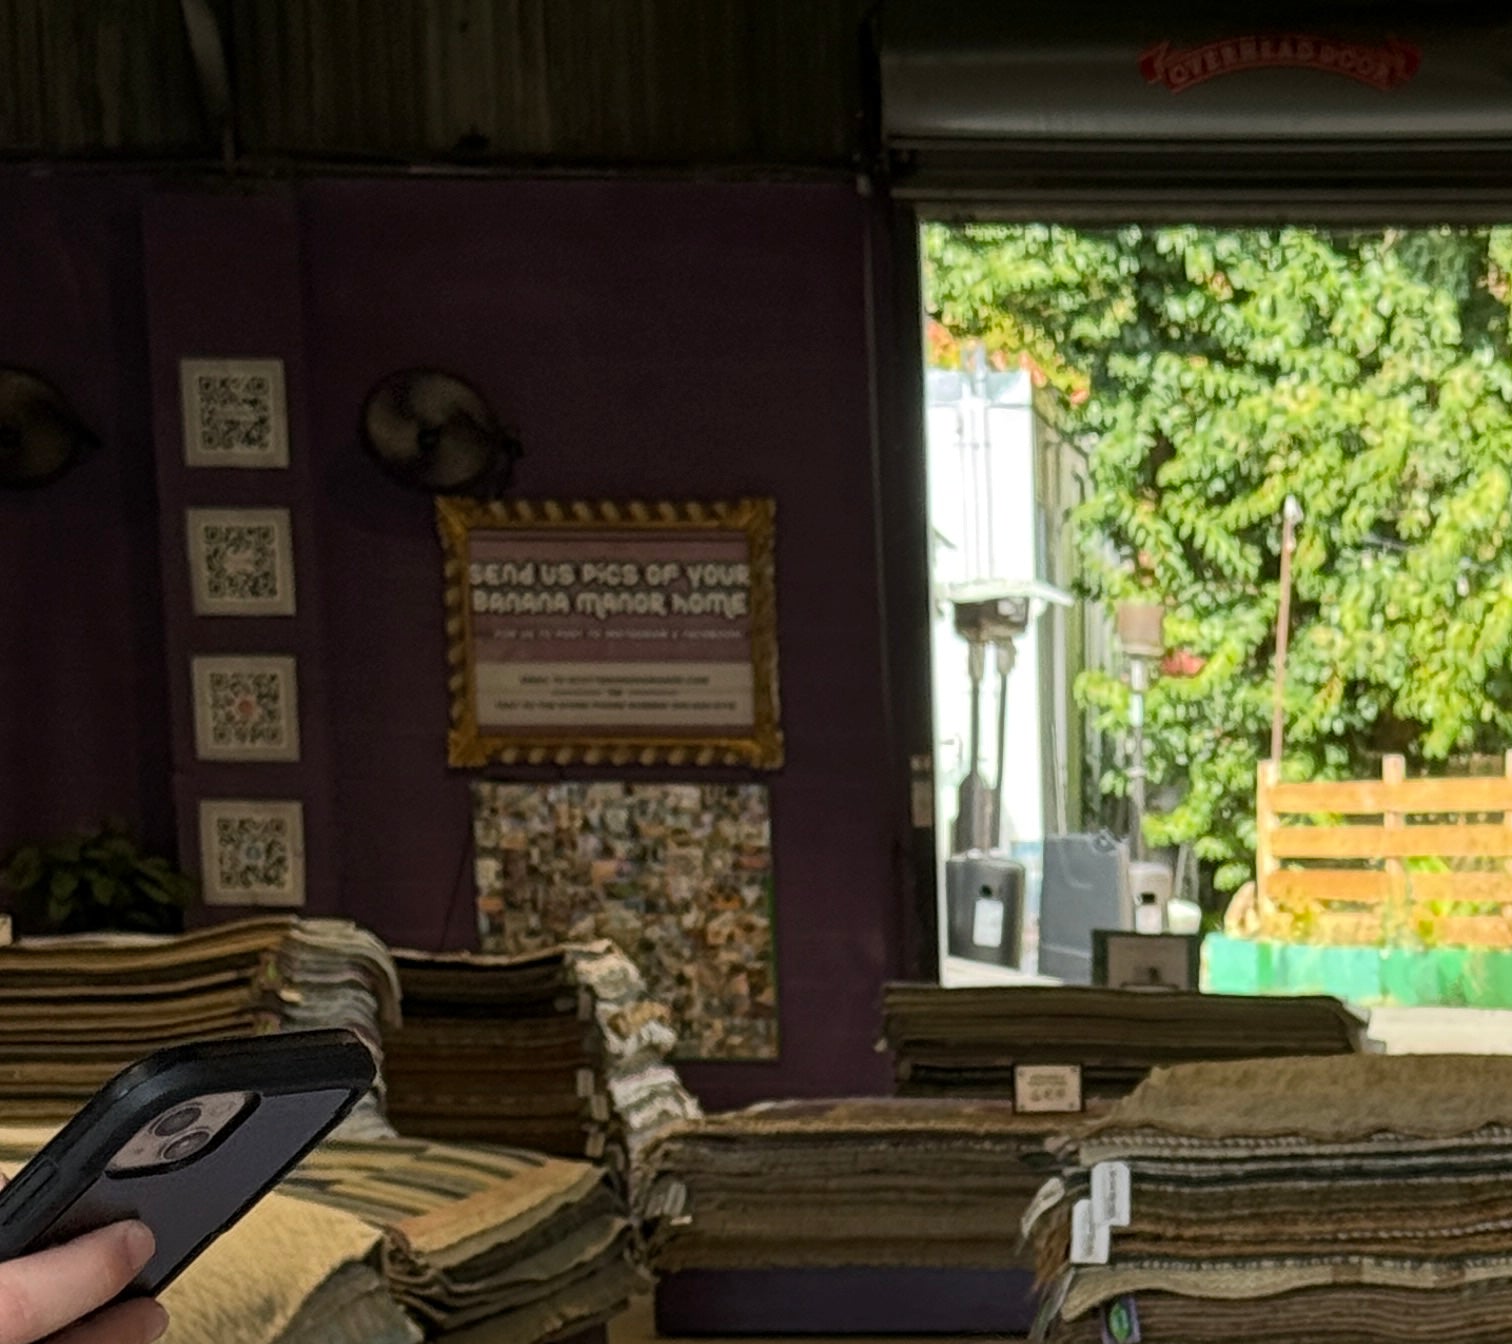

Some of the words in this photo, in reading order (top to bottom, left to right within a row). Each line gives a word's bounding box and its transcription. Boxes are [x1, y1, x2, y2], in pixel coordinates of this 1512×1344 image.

[540, 564, 575, 586] US
[581, 563, 638, 585] PICS
[645, 564, 680, 586] OF
[687, 563, 750, 588] YOUR
[473, 590, 569, 614] BANANA
